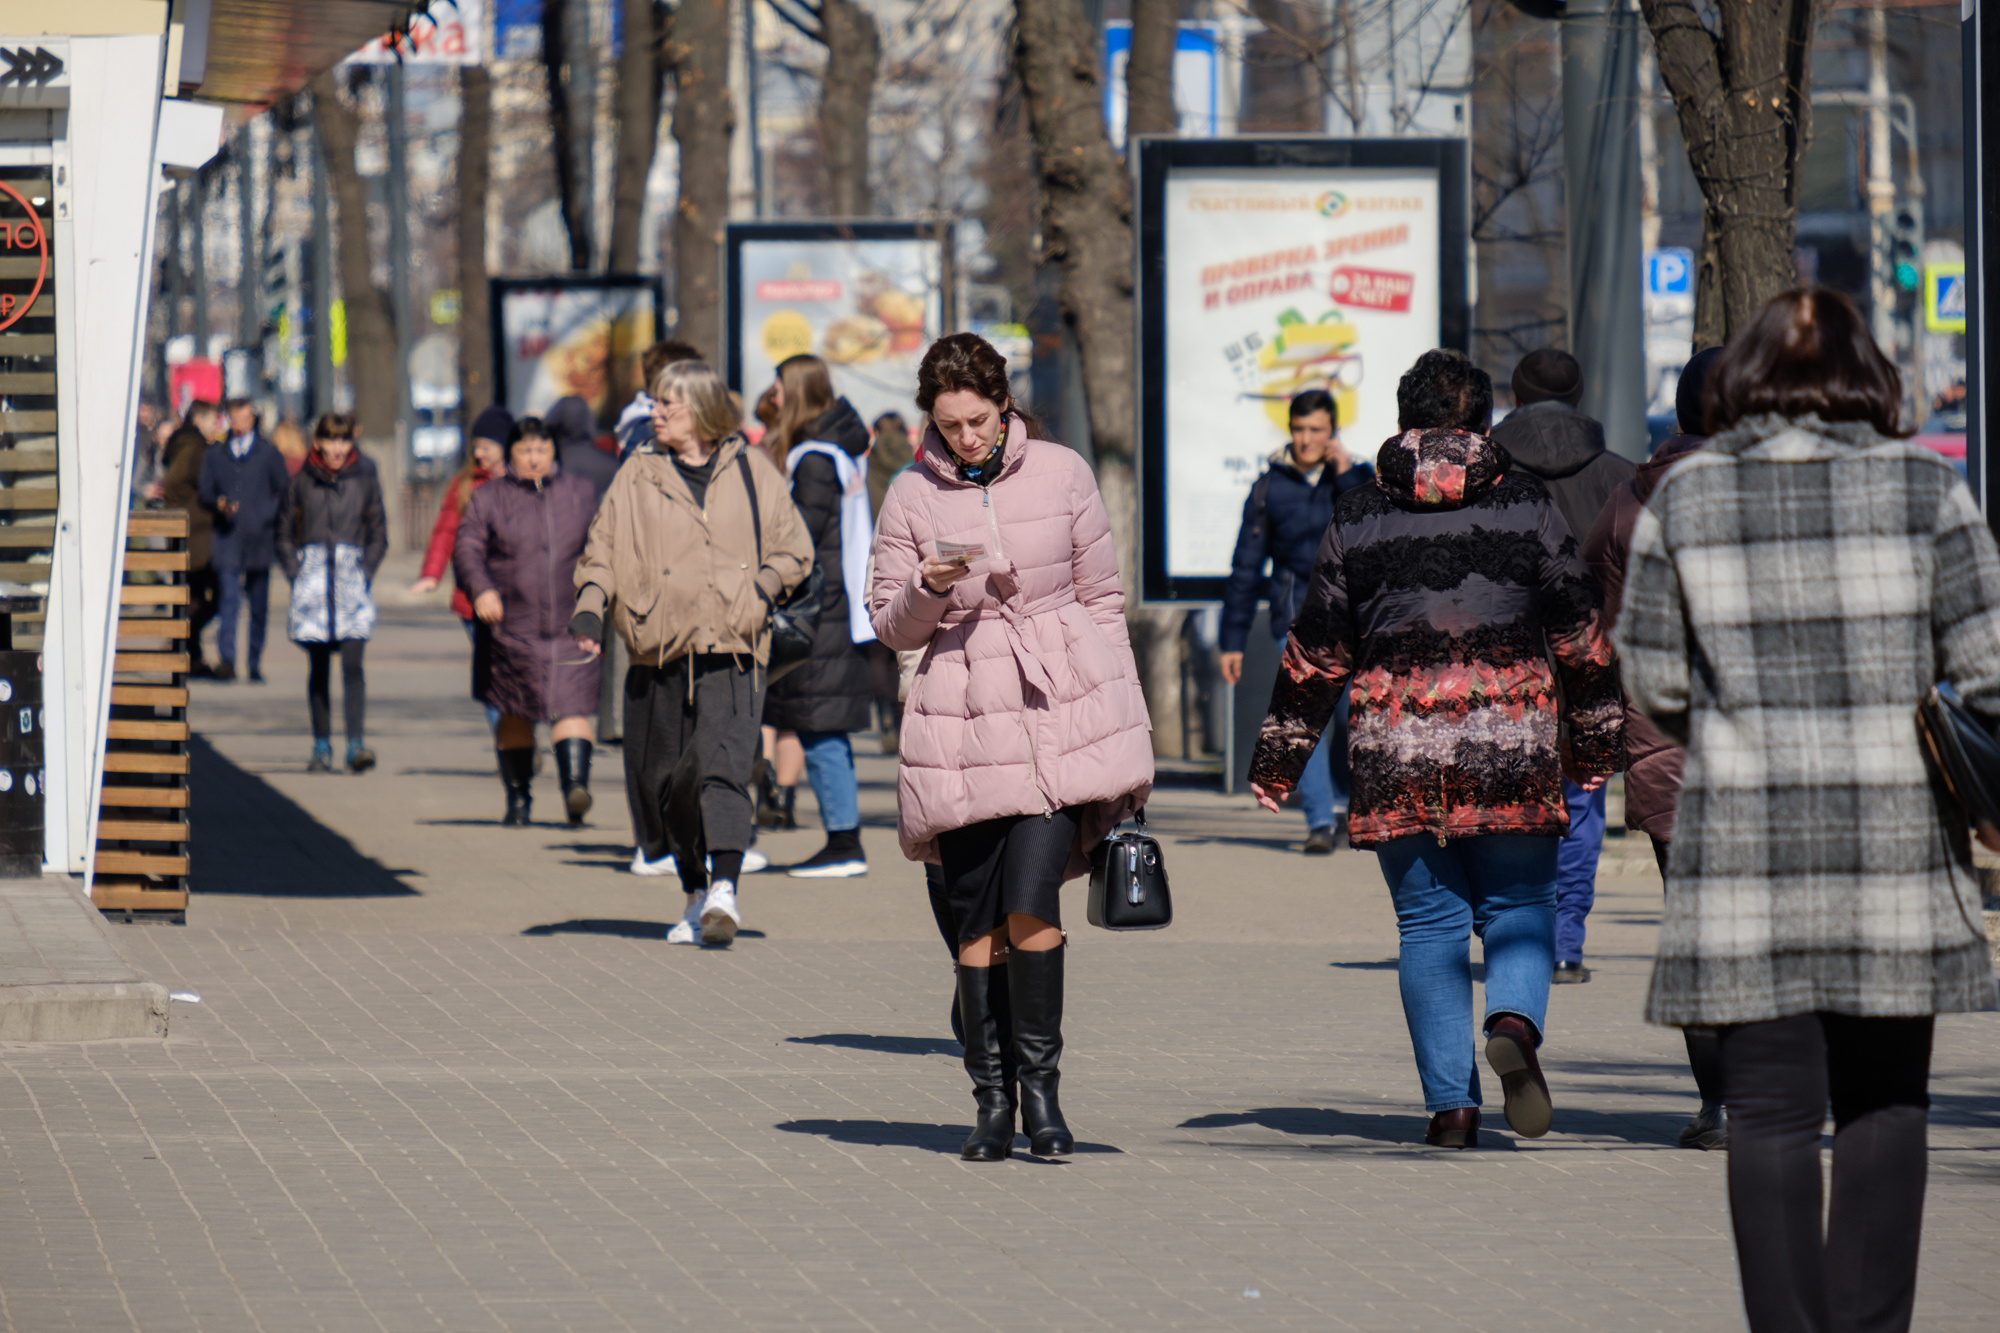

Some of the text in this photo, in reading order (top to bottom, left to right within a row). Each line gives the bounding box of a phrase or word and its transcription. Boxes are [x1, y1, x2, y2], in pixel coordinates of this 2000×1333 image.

[1201, 225, 1408, 284] ПРОВЕРКА ЗРЕНИЯ
[1203, 272, 1313, 311] И ОПРАВА
[1351, 272, 1411, 293] ЗА НАШ
